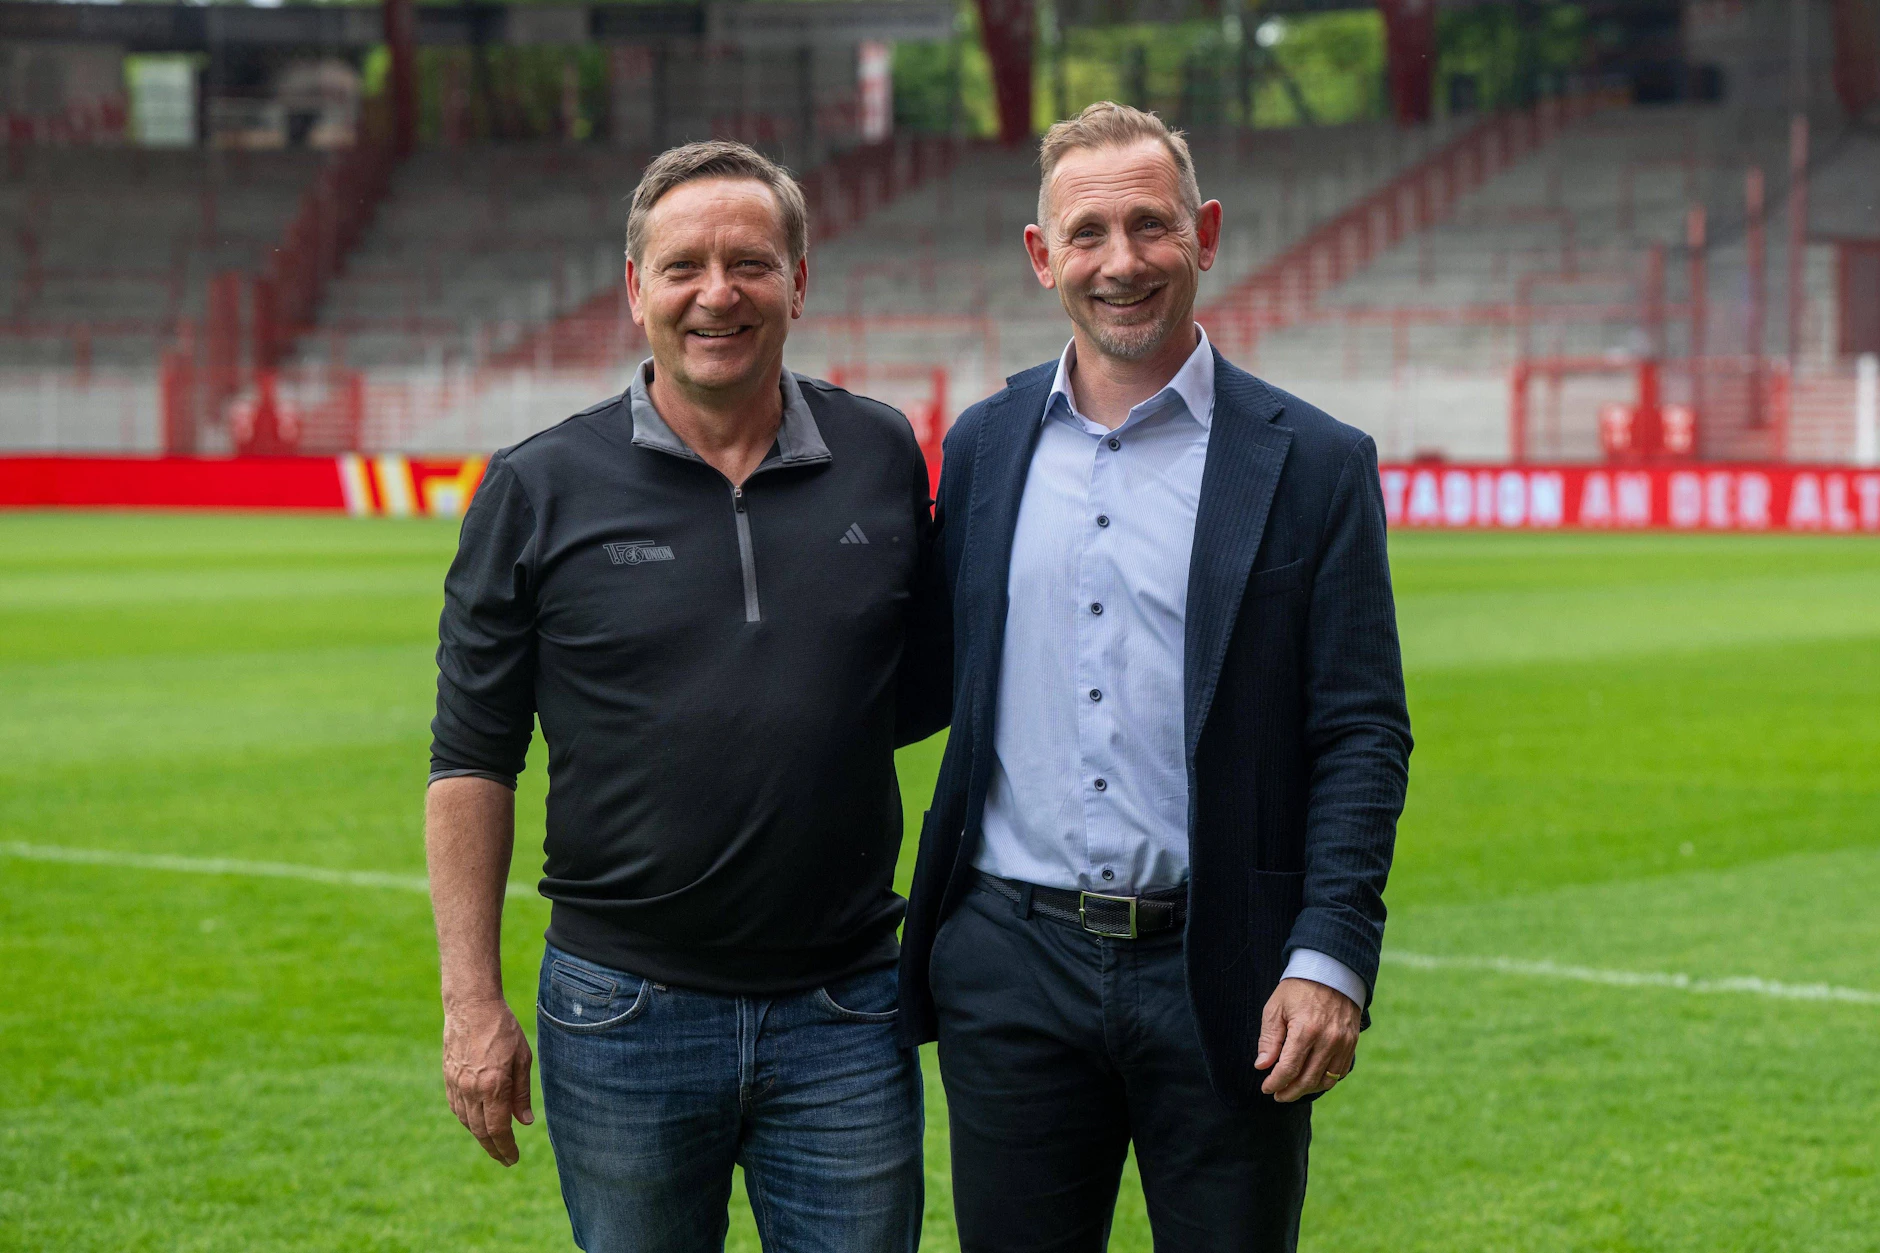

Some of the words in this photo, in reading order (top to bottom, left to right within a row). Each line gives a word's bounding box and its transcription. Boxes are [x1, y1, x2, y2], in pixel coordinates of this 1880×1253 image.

[1382, 469, 1563, 526] TADION
[1578, 470, 1651, 527] AN
[1667, 470, 1771, 528] DER
[643, 546, 674, 561] UNION
